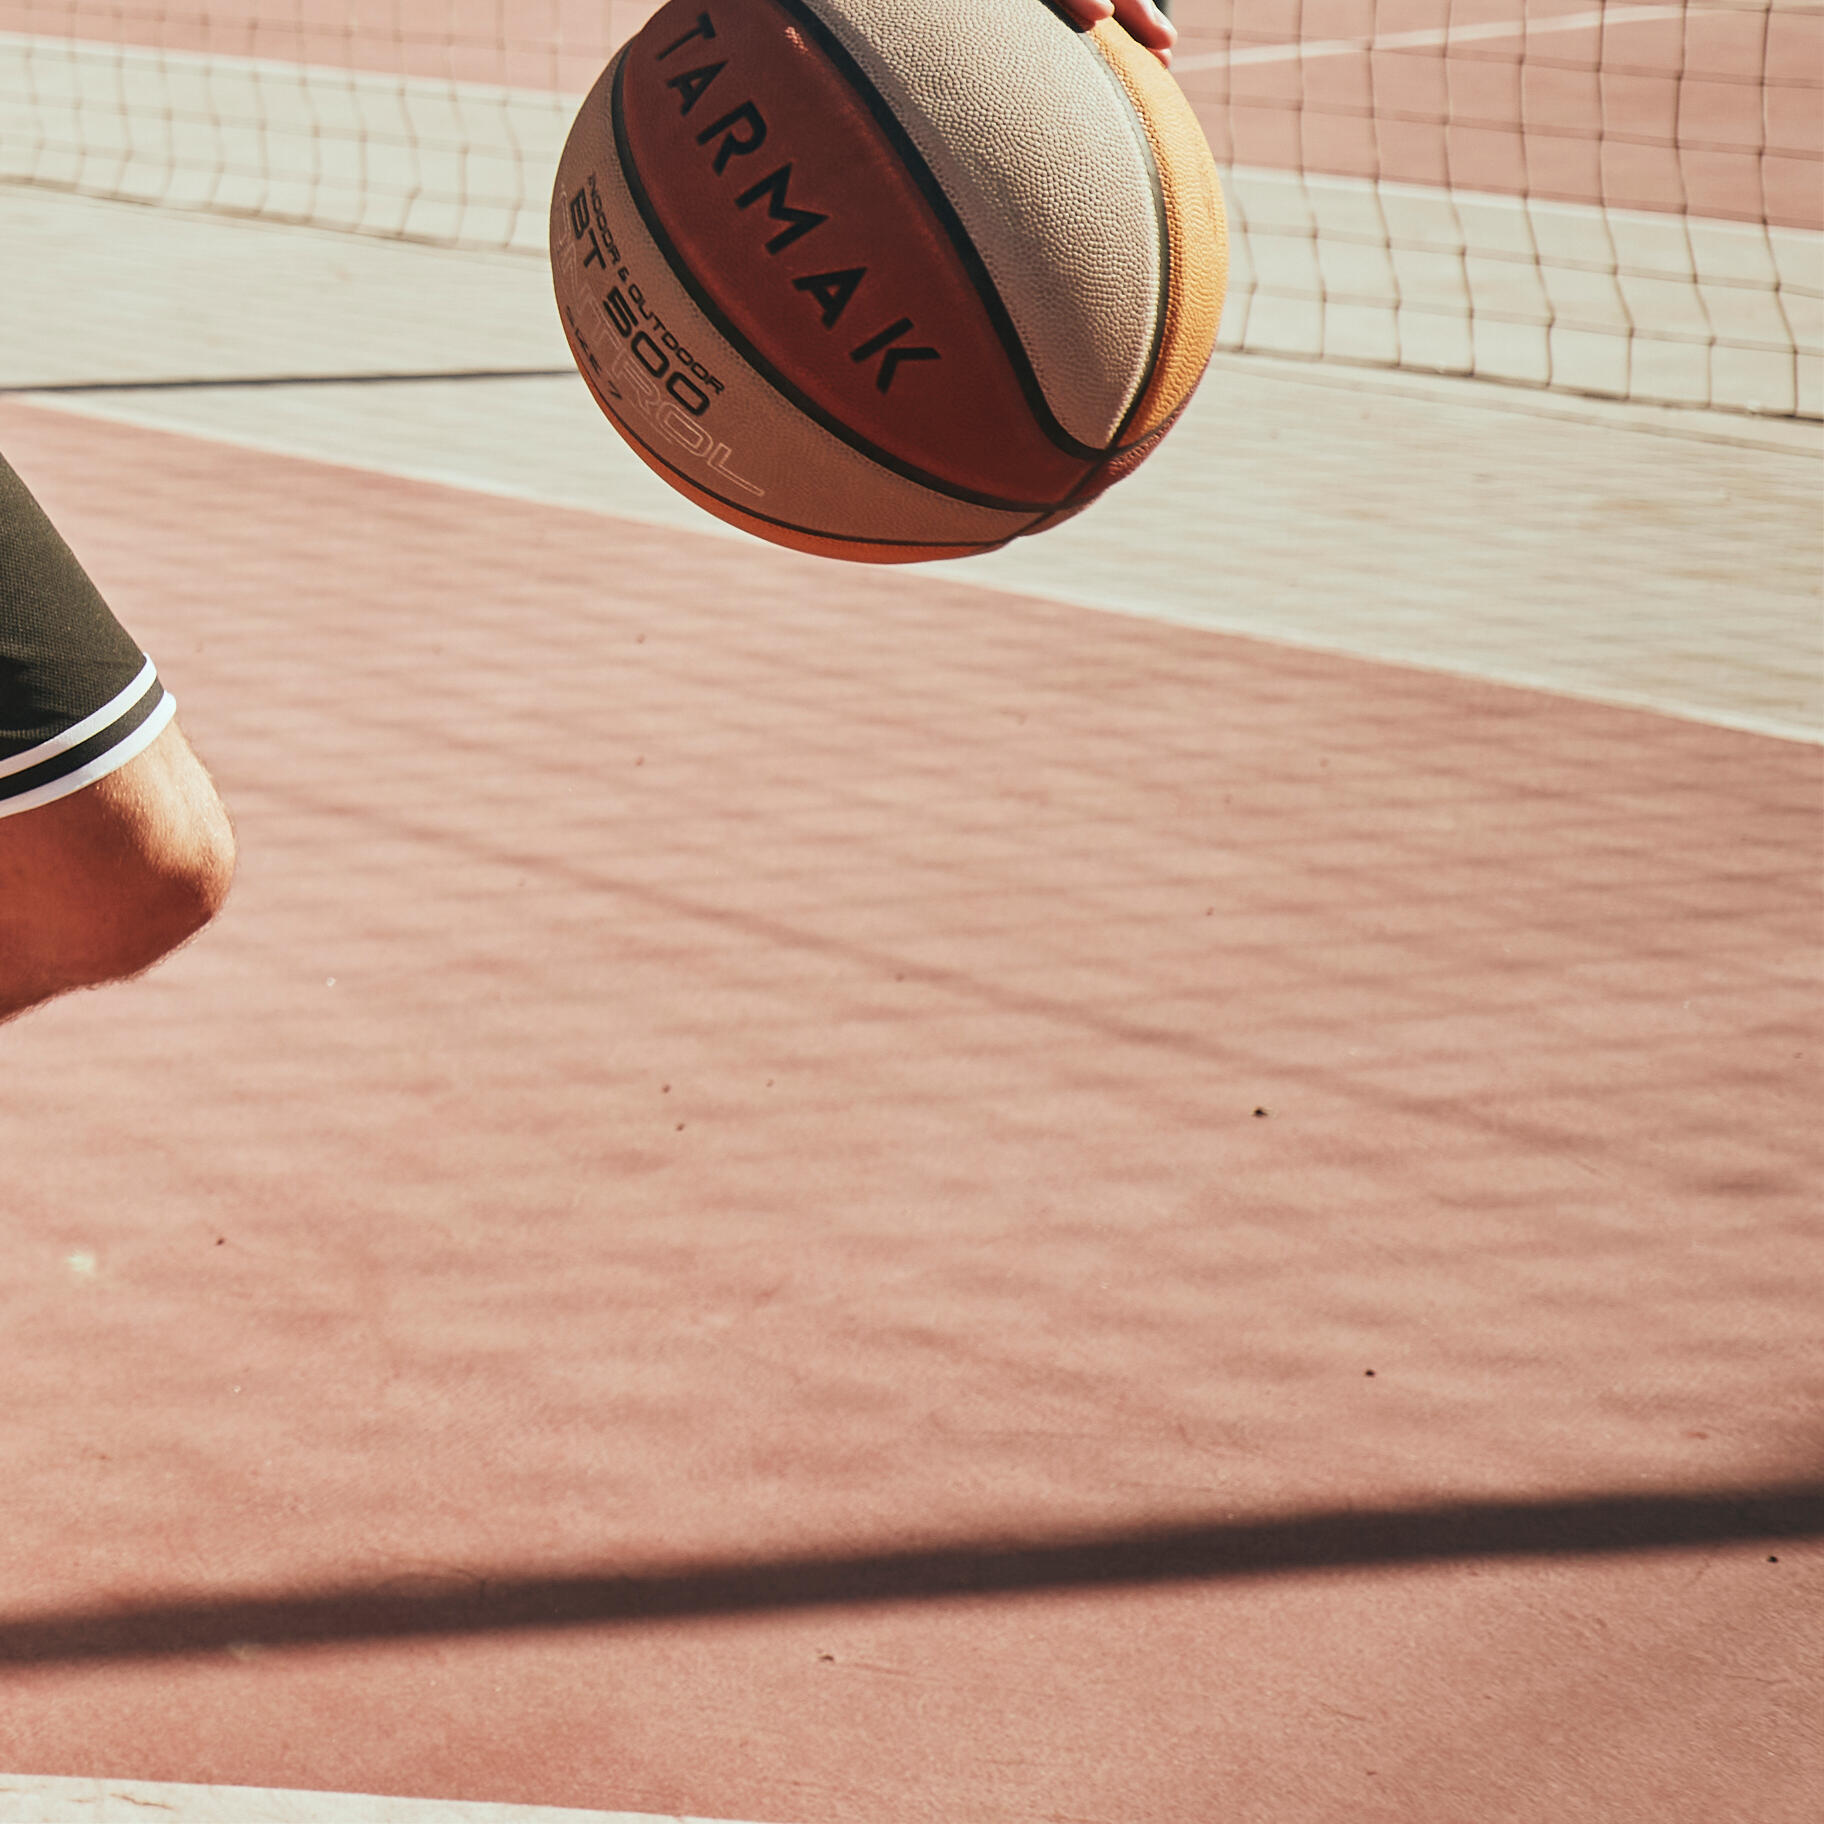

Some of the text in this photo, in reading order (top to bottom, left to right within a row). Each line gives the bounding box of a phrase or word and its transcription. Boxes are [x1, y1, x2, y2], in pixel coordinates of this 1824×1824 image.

[570, 186, 711, 418] BT 500
[656, 11, 942, 396] TARMAK
[627, 282, 725, 396] OUTDOOR
